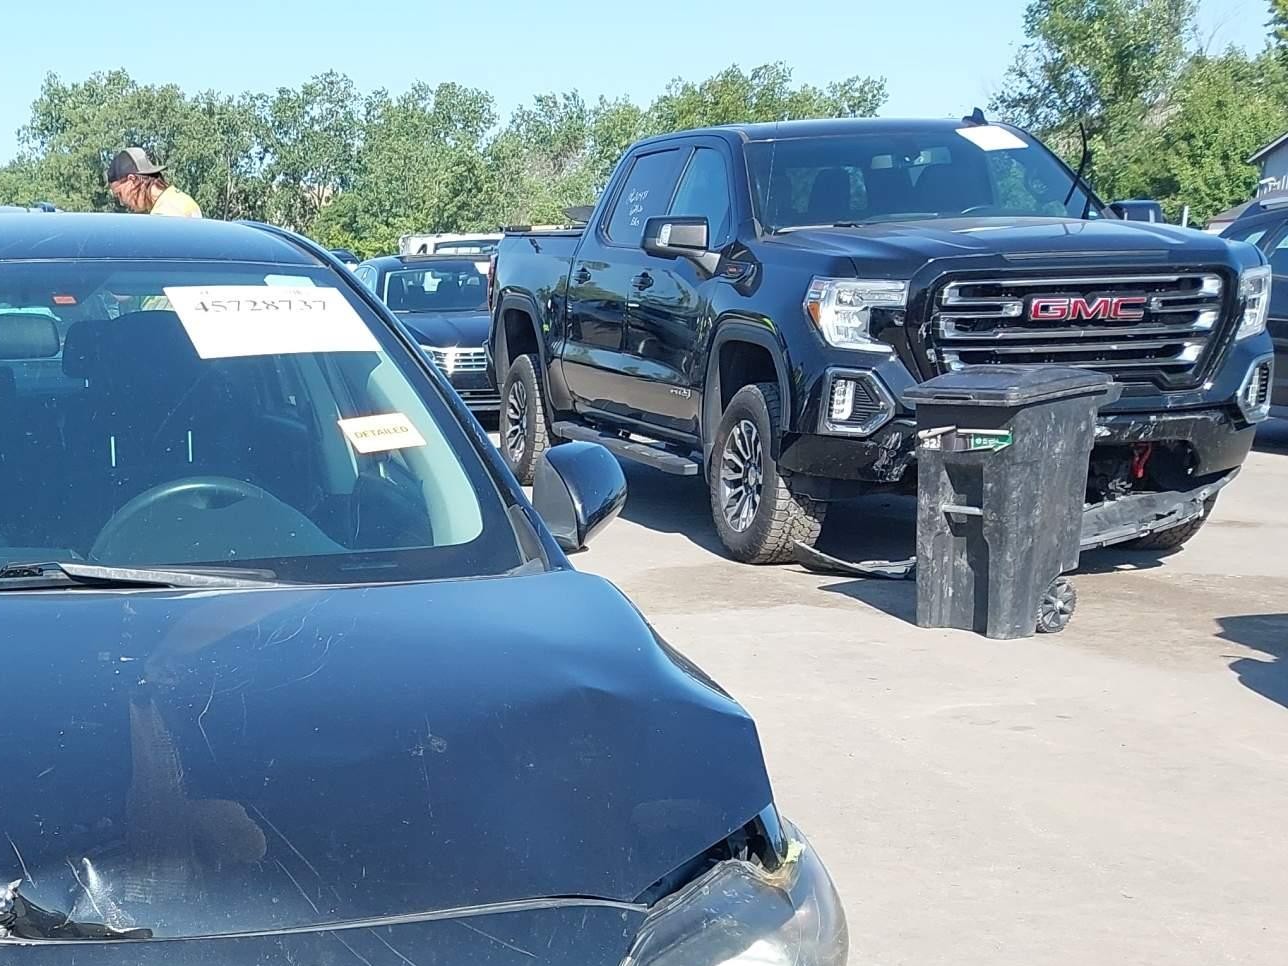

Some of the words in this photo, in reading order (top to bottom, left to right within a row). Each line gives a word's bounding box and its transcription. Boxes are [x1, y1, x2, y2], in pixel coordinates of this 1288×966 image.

[194, 299, 327, 313] 45728737
[1031, 297, 1147, 321] GMC
[353, 425, 410, 439] DETAILED
